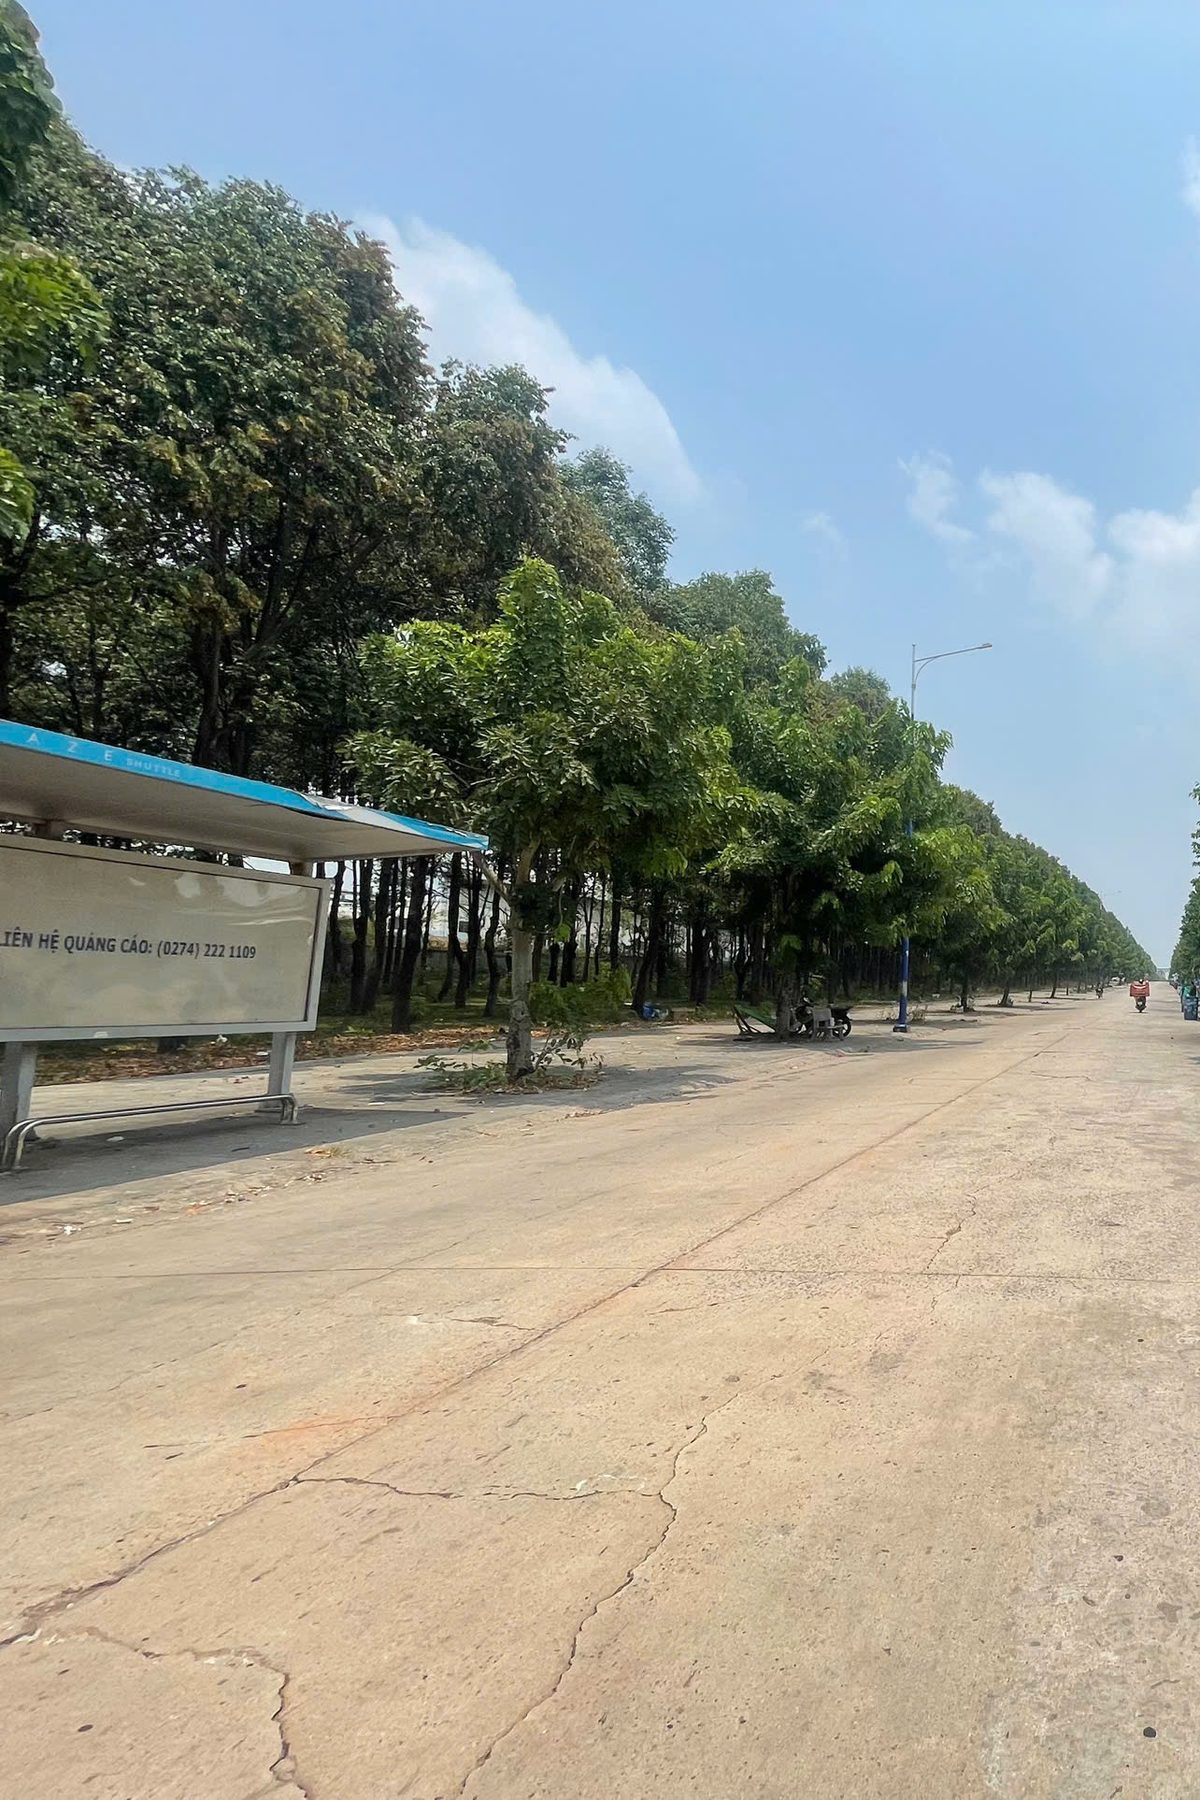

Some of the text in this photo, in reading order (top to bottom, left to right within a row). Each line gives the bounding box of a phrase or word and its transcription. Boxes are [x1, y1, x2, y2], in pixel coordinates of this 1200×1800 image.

[125, 758, 181, 778] SHUTTLE
[38, 929, 59, 954] HỆ
[64, 931, 116, 955] QUẢNG
[120, 934, 153, 955] CÁO:
[157, 939, 200, 960] (0274)
[203, 942, 226, 958] 222
[229, 945, 257, 960] 1109
